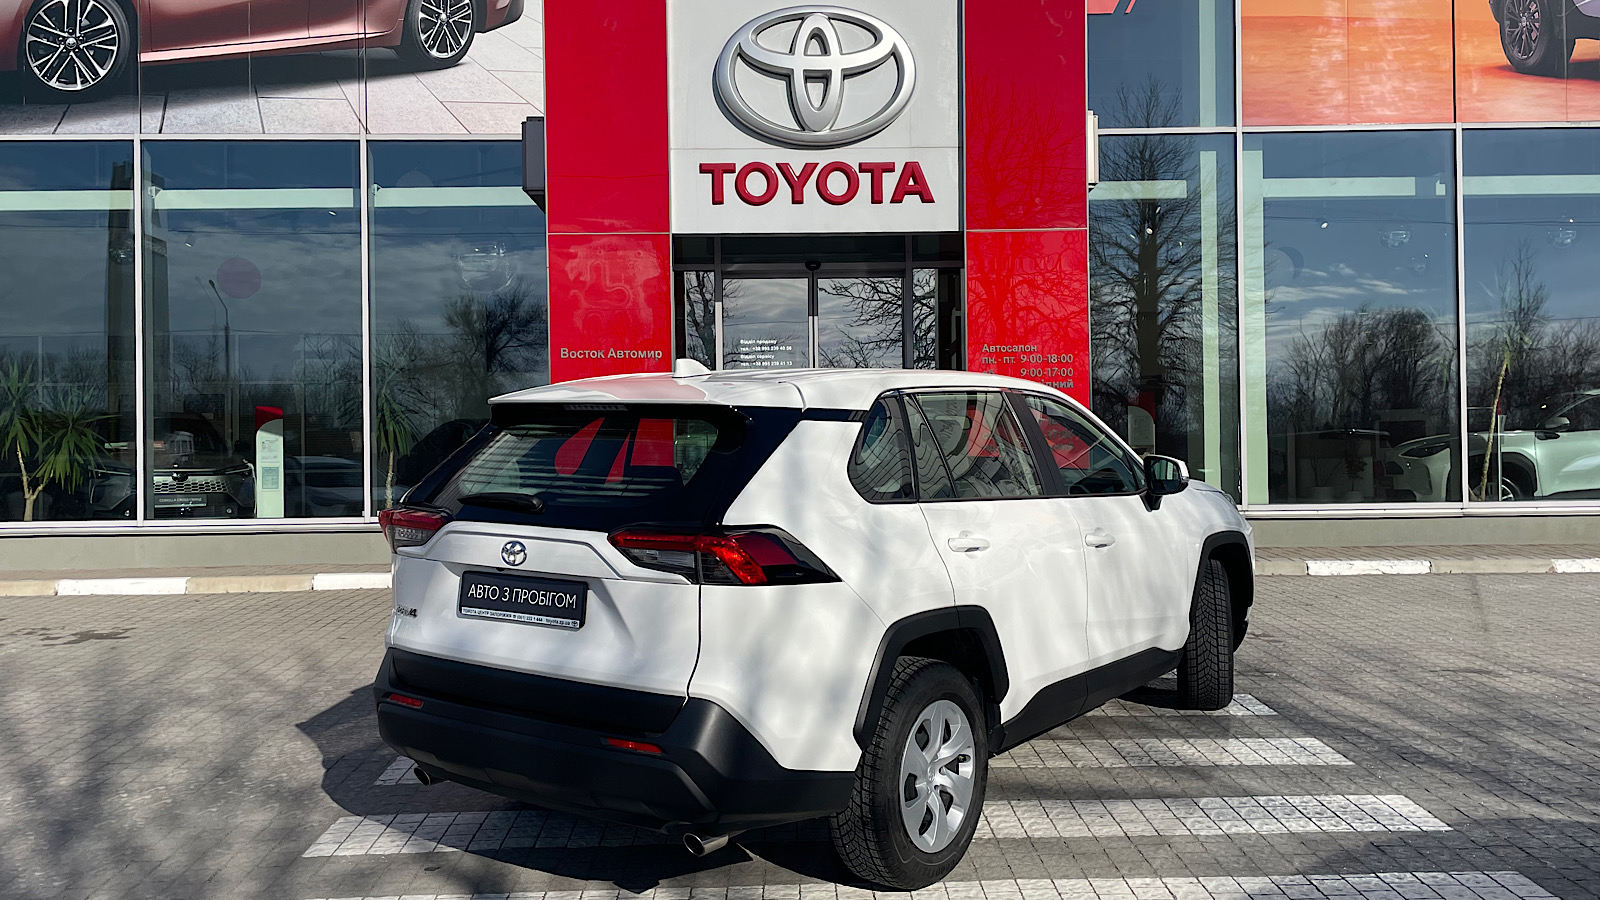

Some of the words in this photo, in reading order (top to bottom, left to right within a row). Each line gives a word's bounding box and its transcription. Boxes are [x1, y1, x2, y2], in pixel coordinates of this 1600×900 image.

[699, 161, 936, 206] TOYOTA
[560, 347, 605, 359] Восток
[607, 347, 663, 361] Автомир
[981, 344, 1038, 353] Автосалон
[981, 356, 997, 364] пн.
[1003, 356, 1016, 364] пт.
[1020, 353, 1074, 363] 9:00-18:00
[468, 584, 500, 600] АВТО
[512, 588, 577, 609] ПРОБІГОМ
